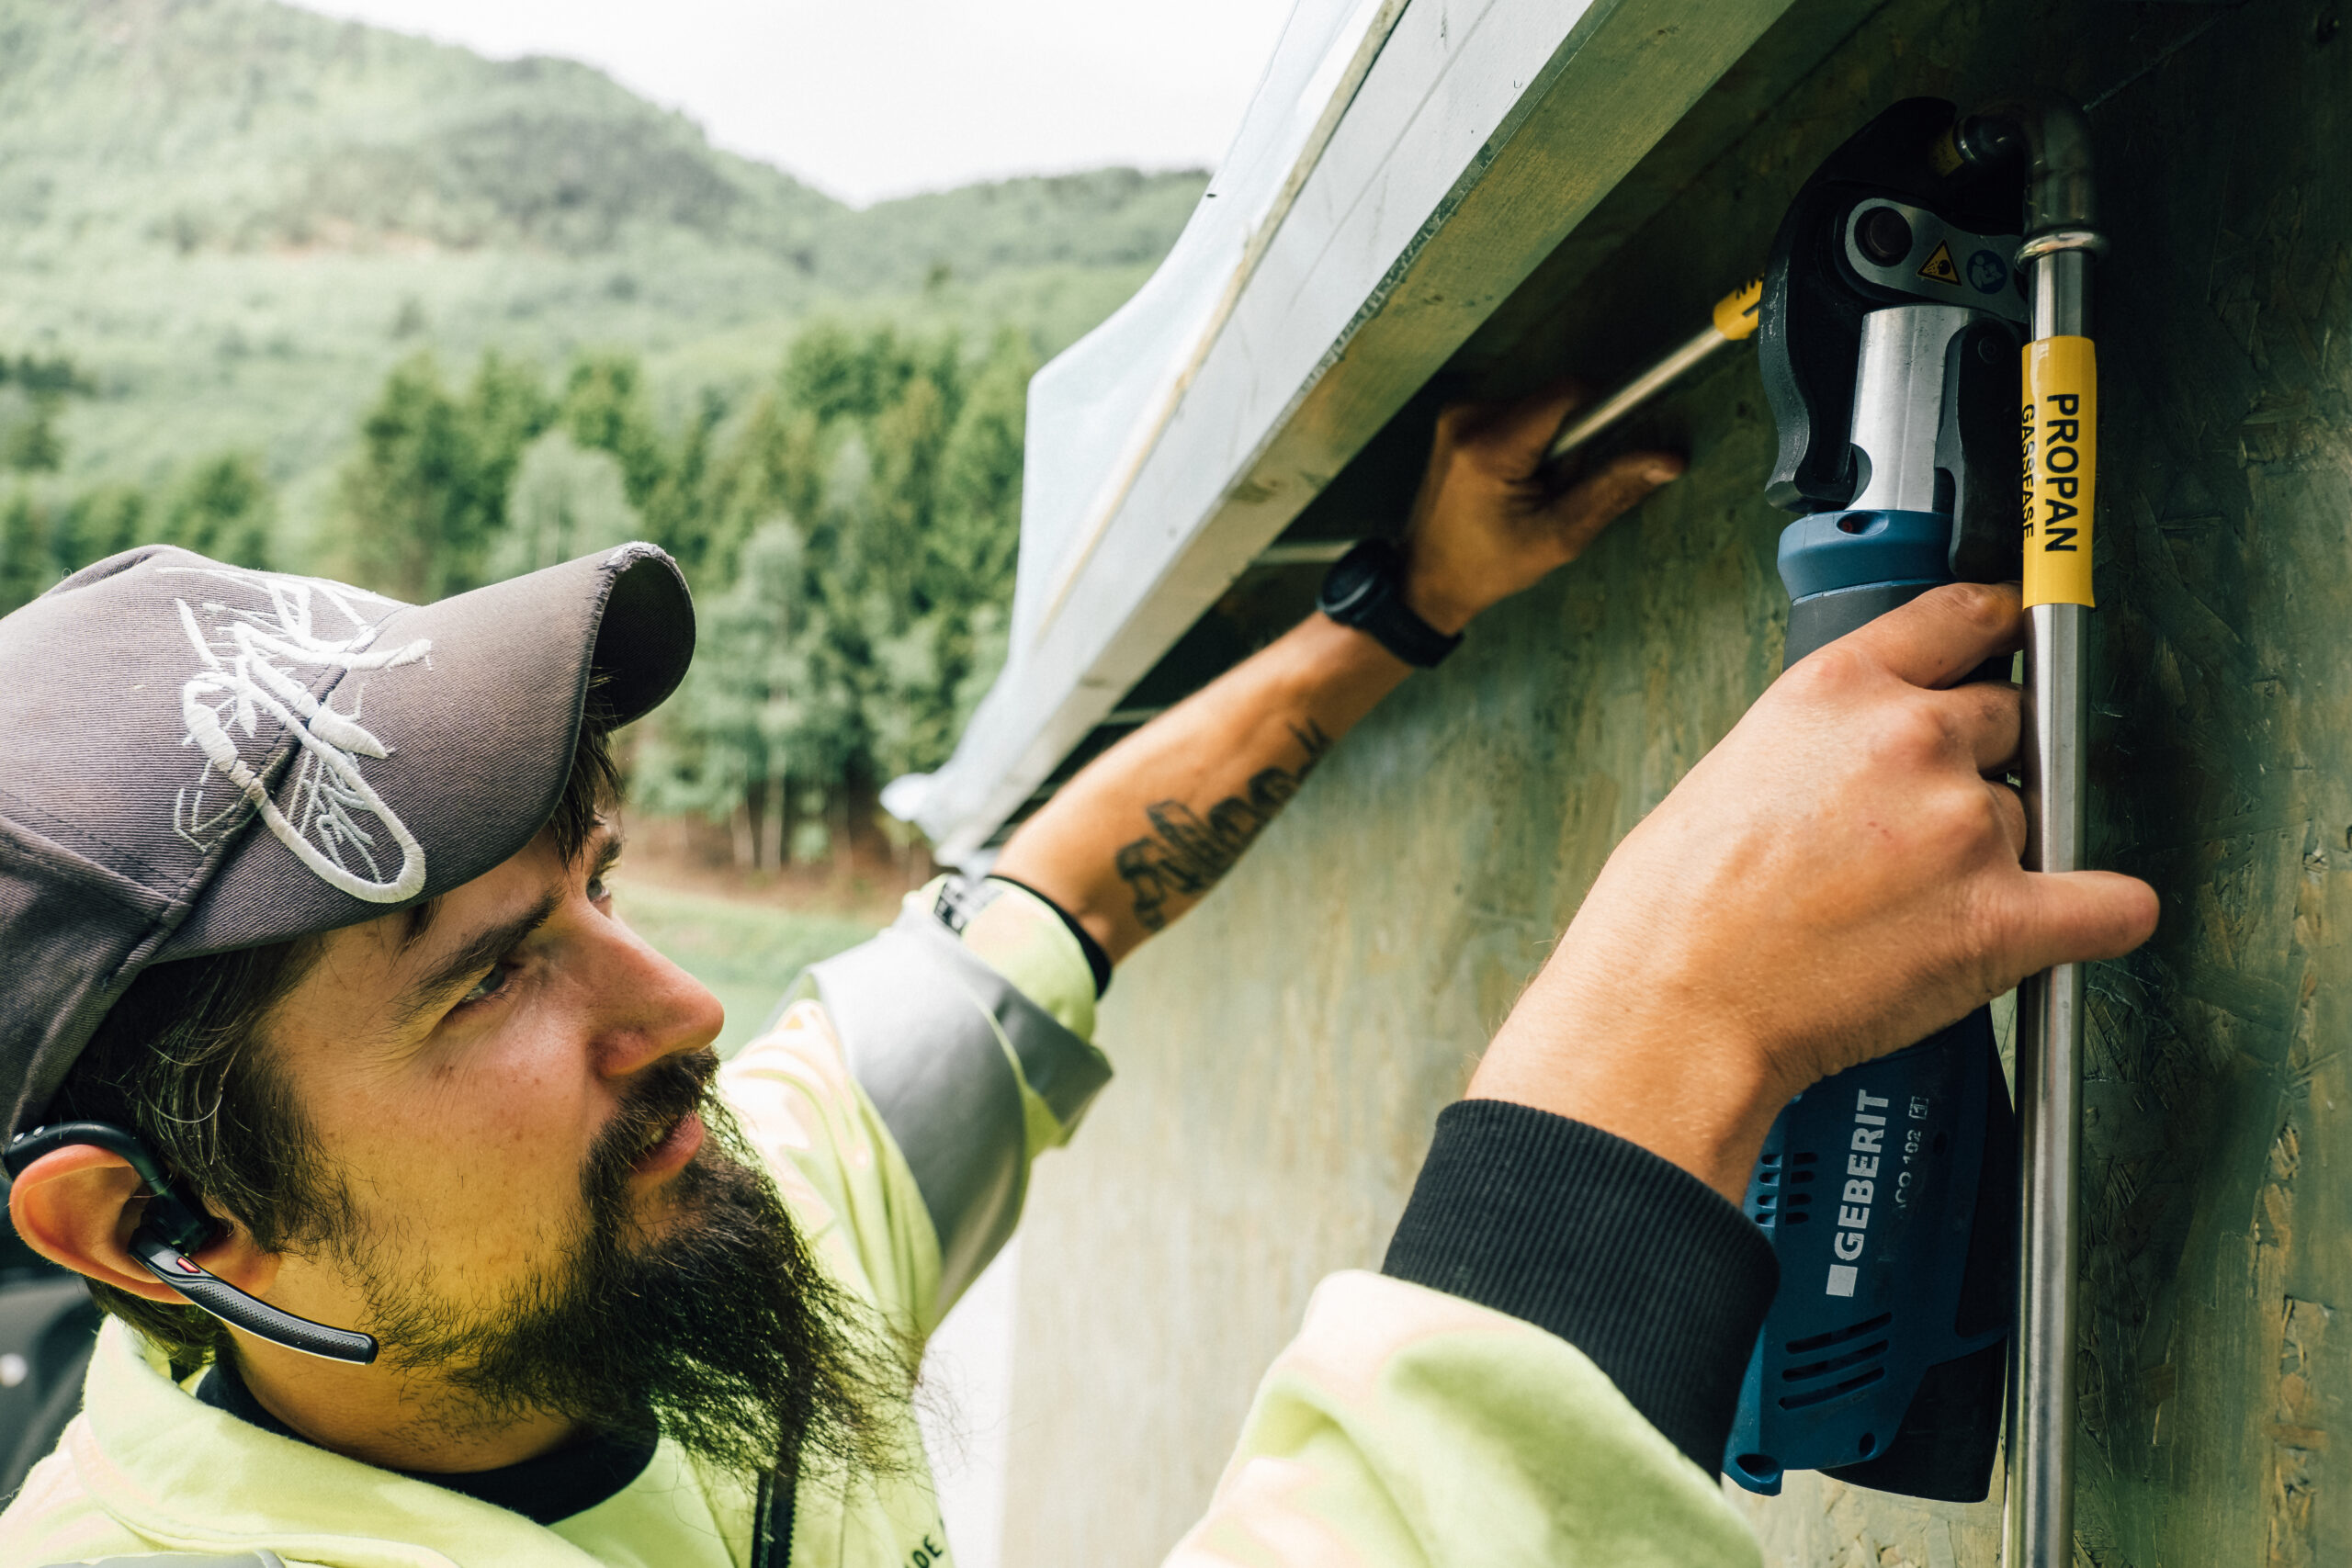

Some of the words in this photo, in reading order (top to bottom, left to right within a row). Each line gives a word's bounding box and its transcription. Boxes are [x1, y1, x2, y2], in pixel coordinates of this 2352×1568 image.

[2044, 393, 2080, 552] PROPAN
[1834, 1089, 1889, 1261] GEBERIT
[905, 1534, 943, 1568] OE
